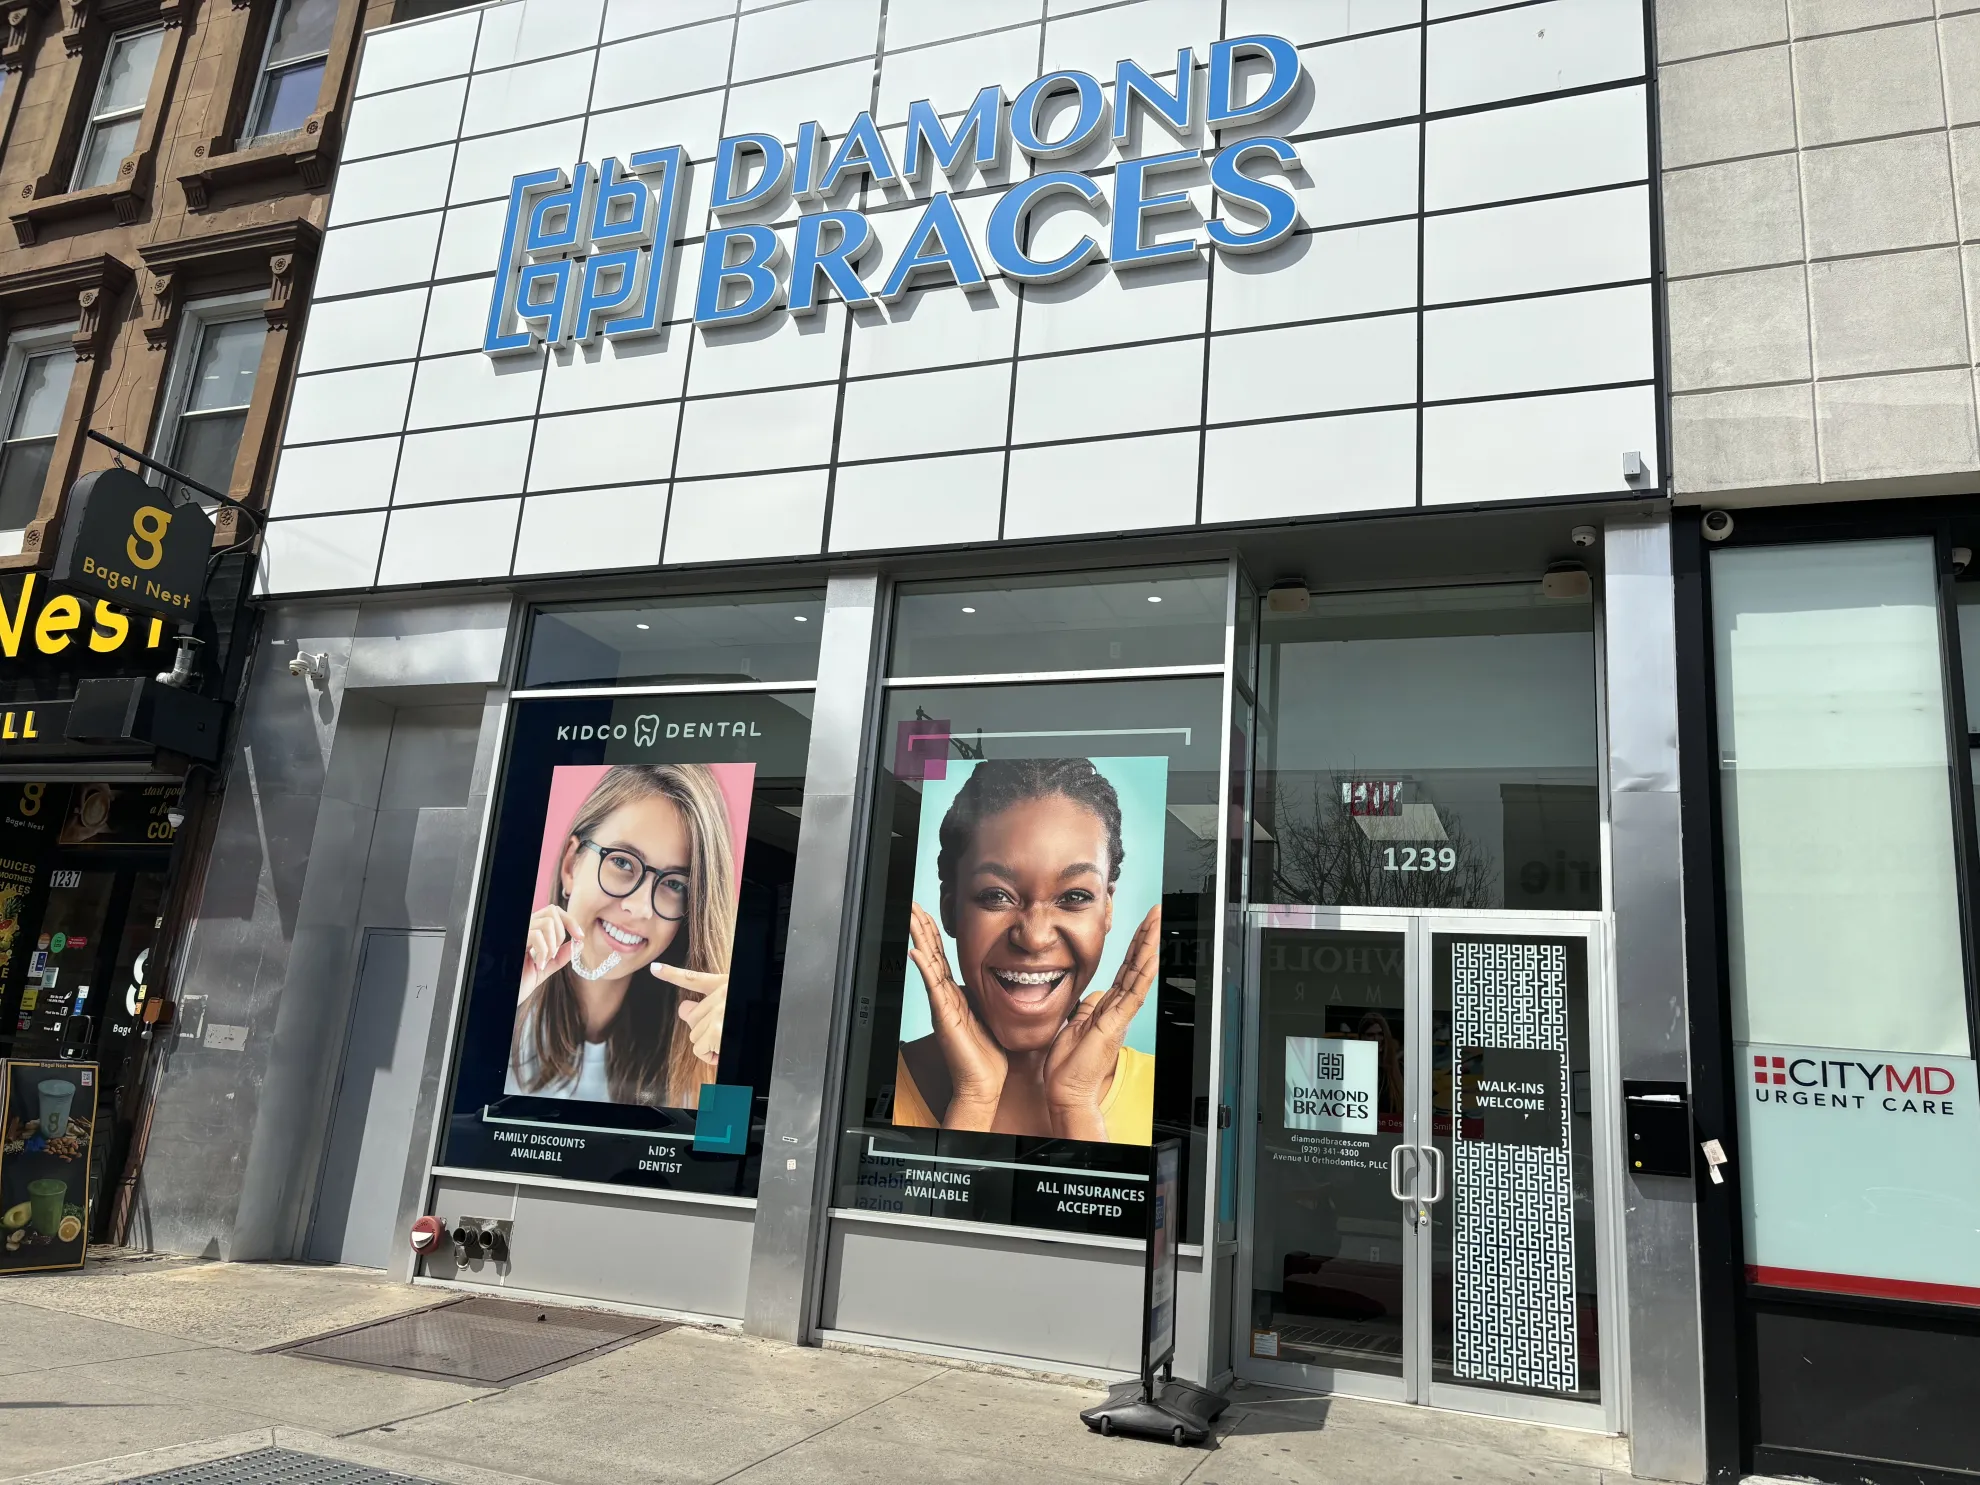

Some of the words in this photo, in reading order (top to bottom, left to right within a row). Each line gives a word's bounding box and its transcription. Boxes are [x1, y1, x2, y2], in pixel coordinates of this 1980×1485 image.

[711, 33, 1304, 214] DIAMOND
[693, 134, 1302, 329] BRACES
[82, 556, 138, 590] Bagel
[145, 580, 191, 609] Nest
[556, 724, 628, 741] KIDCO
[665, 721, 762, 738] DENTAL
[1350, 782, 1398, 816] EXIT
[5, 816, 27, 829] Bagel
[27, 821, 45, 831] Nest
[1383, 847, 1456, 872] 1239
[52, 872, 81, 887] 1237
[1788, 1058, 1955, 1095] CITYMD
[1293, 1086, 1369, 1103] DIAMOND
[1477, 1080, 1545, 1095] WALK-INS
[1292, 1099, 1369, 1120] BRACES
[1475, 1095, 1545, 1111] WELCOME
[1755, 1088, 1865, 1109] URGENT
[1882, 1097, 1955, 1115] CARE
[493, 1131, 529, 1144] FAMILY
[530, 1134, 586, 1149] DISCOUNTS
[1291, 1134, 1370, 1149] diamondbraces.com
[510, 1147, 563, 1162] AVAILABLE
[648, 1144, 676, 1158] KID'S
[1300, 1145, 1321, 1156] (929)
[1322, 1146, 1360, 1158] 341-4300
[638, 1160, 682, 1174] DENTIST
[1273, 1152, 1302, 1164] Avenue
[1303, 1155, 1310, 1164] U
[1312, 1156, 1367, 1170] Orthodontics,
[1368, 1159, 1389, 1171] PLLC
[905, 1168, 971, 1186] FINANCING
[904, 1186, 969, 1203] AVAILABLE
[1036, 1180, 1060, 1195] ALL
[1063, 1183, 1145, 1203] INSURANCES
[855, 1195, 904, 1213] azing
[1056, 1200, 1122, 1218] ACCEPTED
